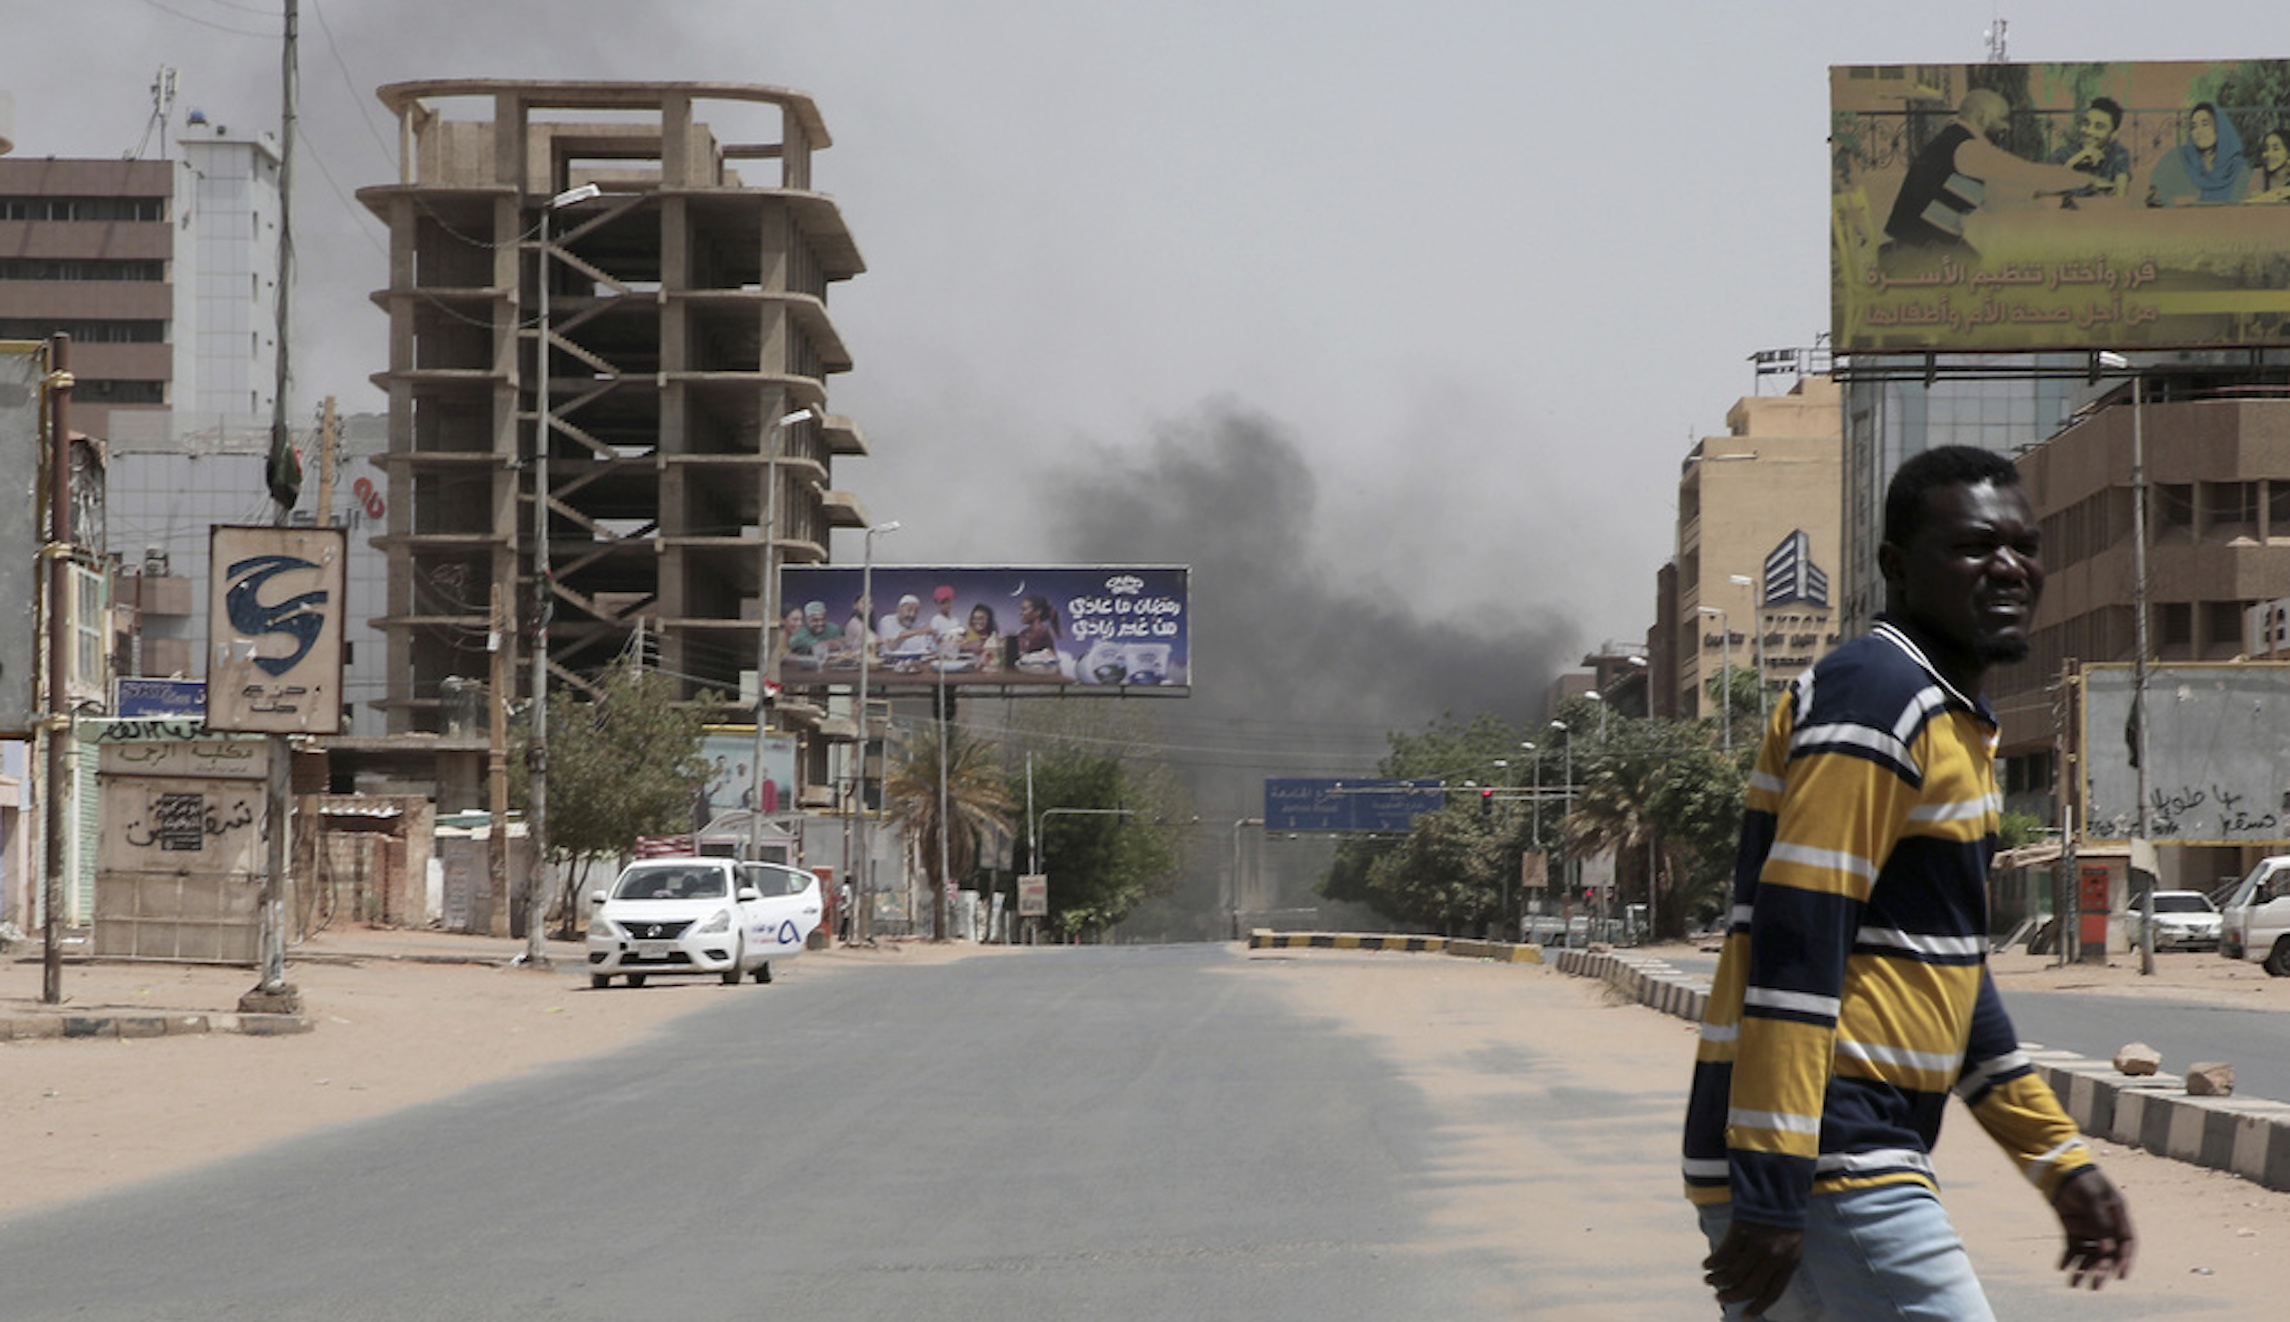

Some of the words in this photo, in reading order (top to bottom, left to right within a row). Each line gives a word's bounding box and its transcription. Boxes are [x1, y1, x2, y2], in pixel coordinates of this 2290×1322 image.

[1968, 261, 2043, 292] تنظيم
[2050, 253, 2117, 290] وأختار
[2123, 258, 2157, 290] قرر
[1863, 296, 1960, 330] وأطفالها
[1964, 295, 2007, 332] الأم
[2010, 303, 2070, 323] صحة
[2075, 293, 2122, 328] أجل
[2122, 303, 2158, 326] من
[1068, 595, 1113, 619] عادي
[1114, 598, 1132, 614] ما
[1133, 596, 1181, 616] رمضان
[1071, 618, 1115, 641] زبادي
[1151, 617, 1178, 635] من
